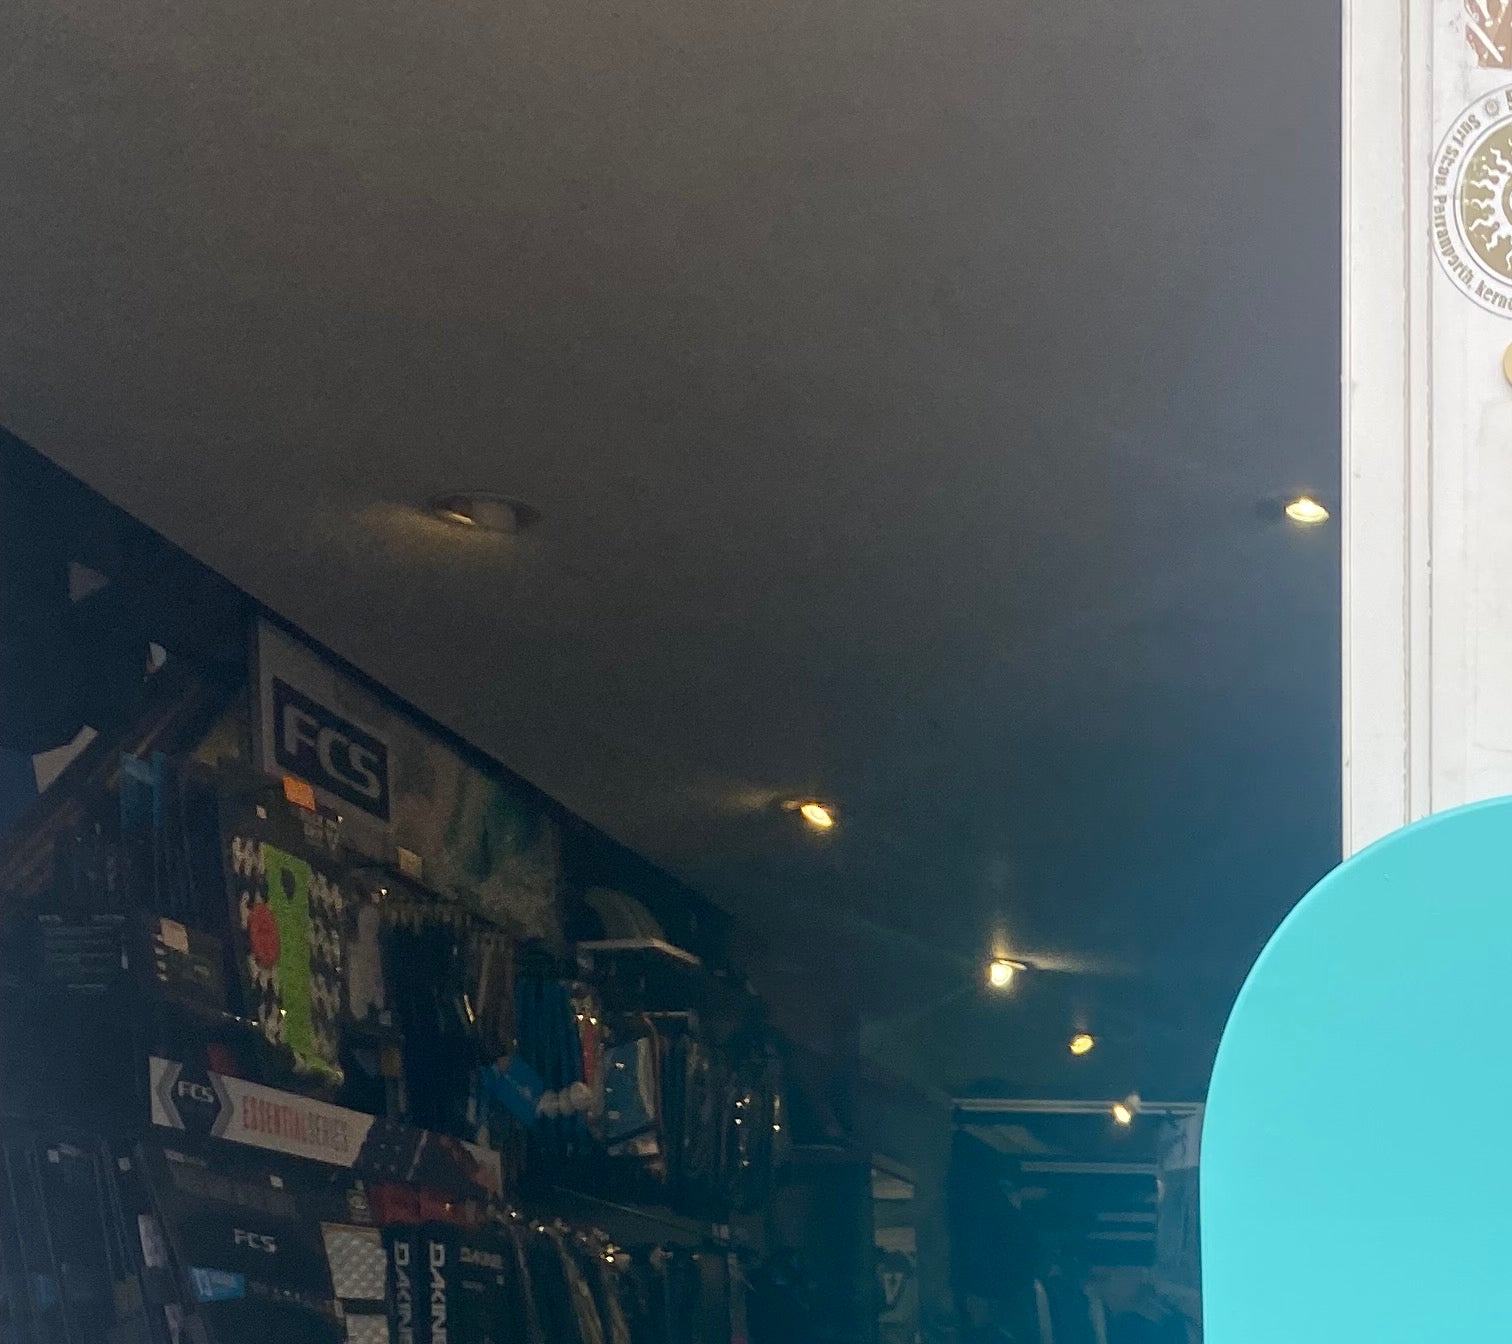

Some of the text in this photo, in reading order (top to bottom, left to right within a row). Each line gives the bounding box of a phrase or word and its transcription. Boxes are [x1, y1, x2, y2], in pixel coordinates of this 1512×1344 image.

[279, 700, 381, 800] FCS
[177, 1081, 214, 1104] FCS
[233, 1227, 276, 1254] FCS
